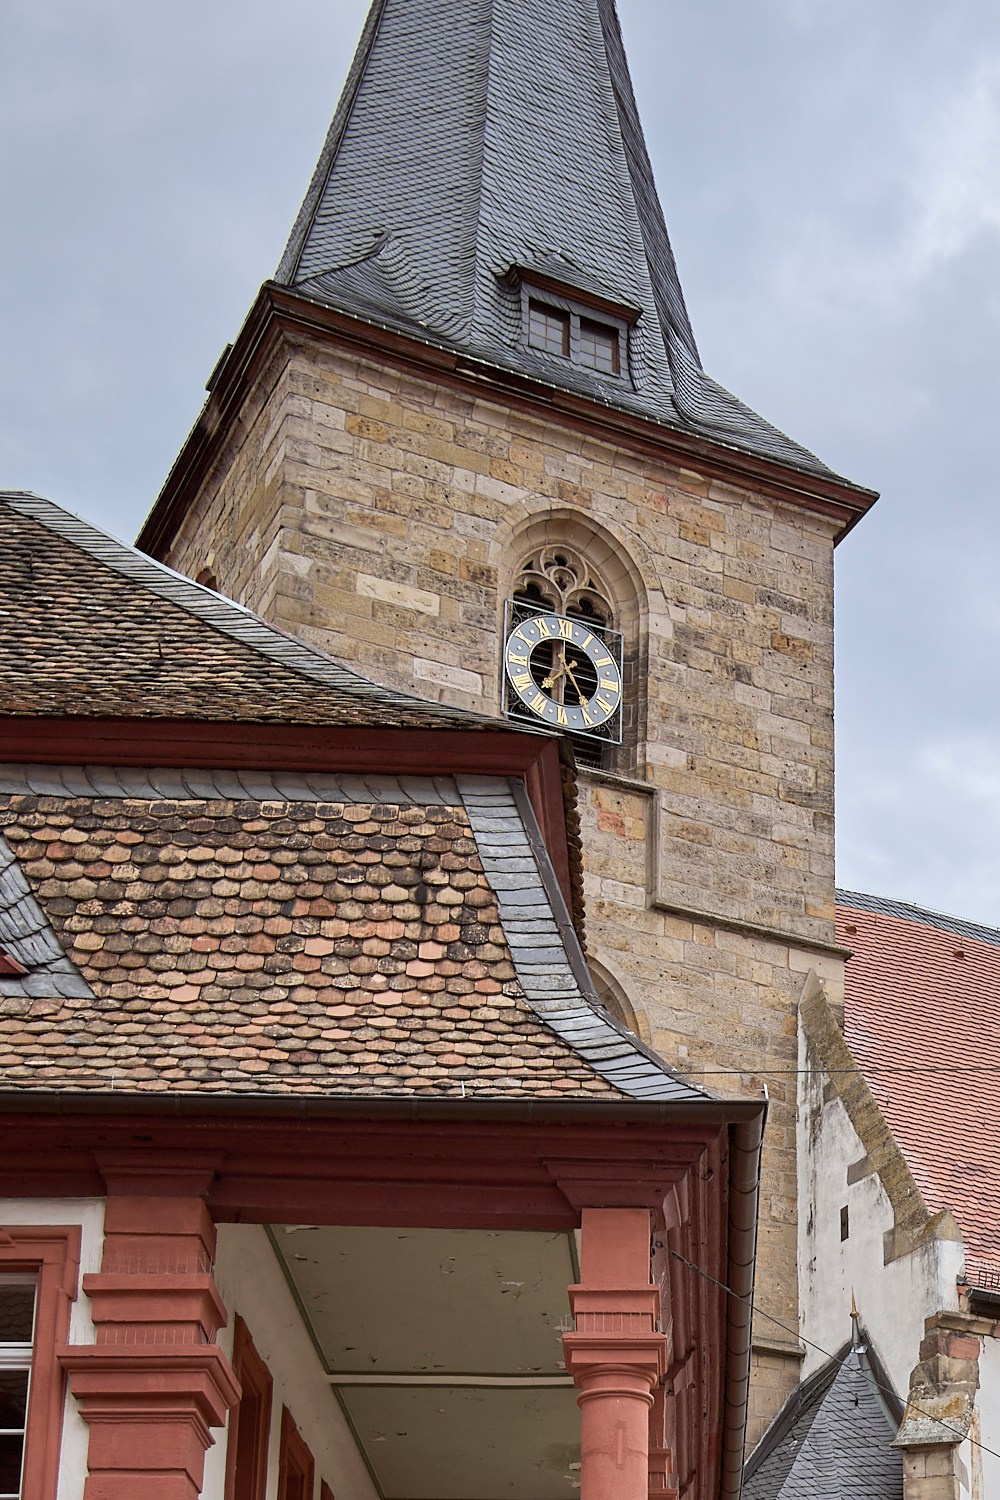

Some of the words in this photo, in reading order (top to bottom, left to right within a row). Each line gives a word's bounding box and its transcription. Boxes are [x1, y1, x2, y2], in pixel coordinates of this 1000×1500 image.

[533, 619, 552, 639] XI
[557, 618, 574, 640] XII
[515, 630, 535, 648] X
[581, 634, 594, 650] I
[508, 651, 528, 667] IX
[594, 657, 613, 668] II
[511, 674, 534, 693] VIII
[599, 678, 620, 693] III
[528, 692, 548, 714] VII
[594, 694, 614, 716] IV
[556, 706, 569, 726] VI
[581, 707, 594, 726] V
